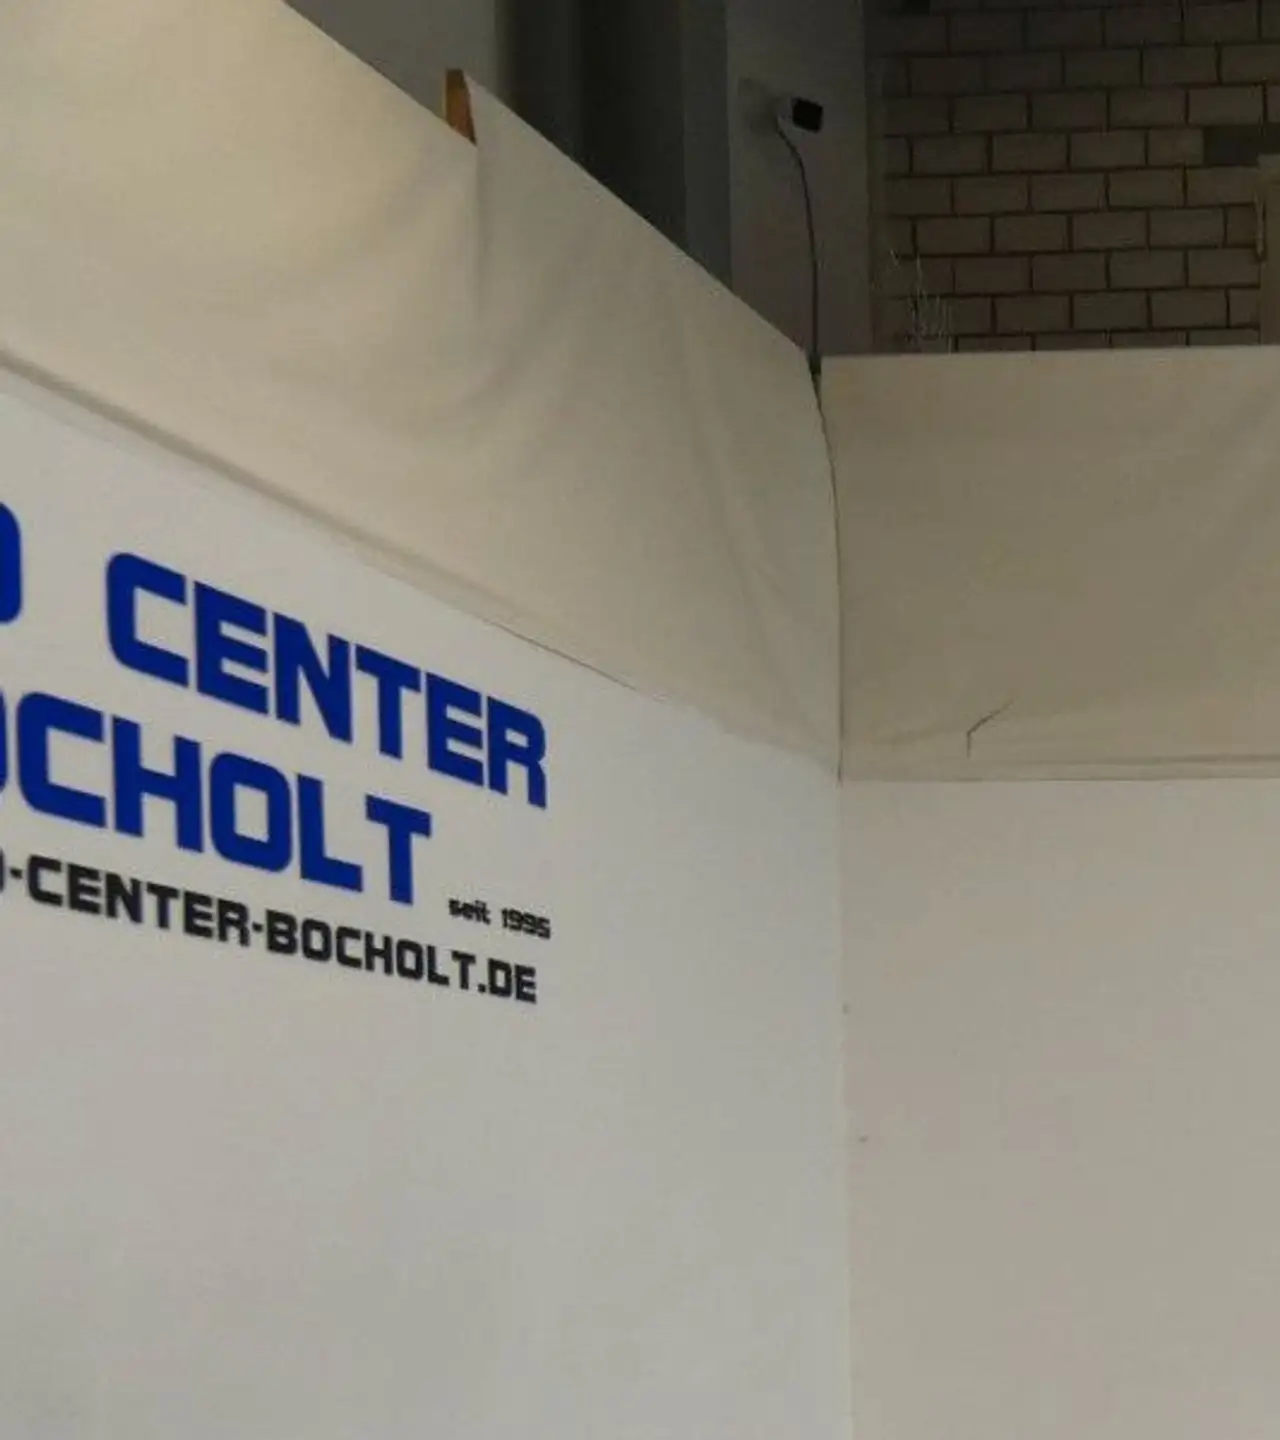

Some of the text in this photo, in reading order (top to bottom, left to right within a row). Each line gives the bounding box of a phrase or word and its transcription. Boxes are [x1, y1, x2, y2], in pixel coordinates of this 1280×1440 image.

[105, 553, 547, 811] CENTER
[0, 688, 551, 941] CHOLT seit 1995
[0, 849, 537, 1004] -CENTER-BOCHOLT.DE
